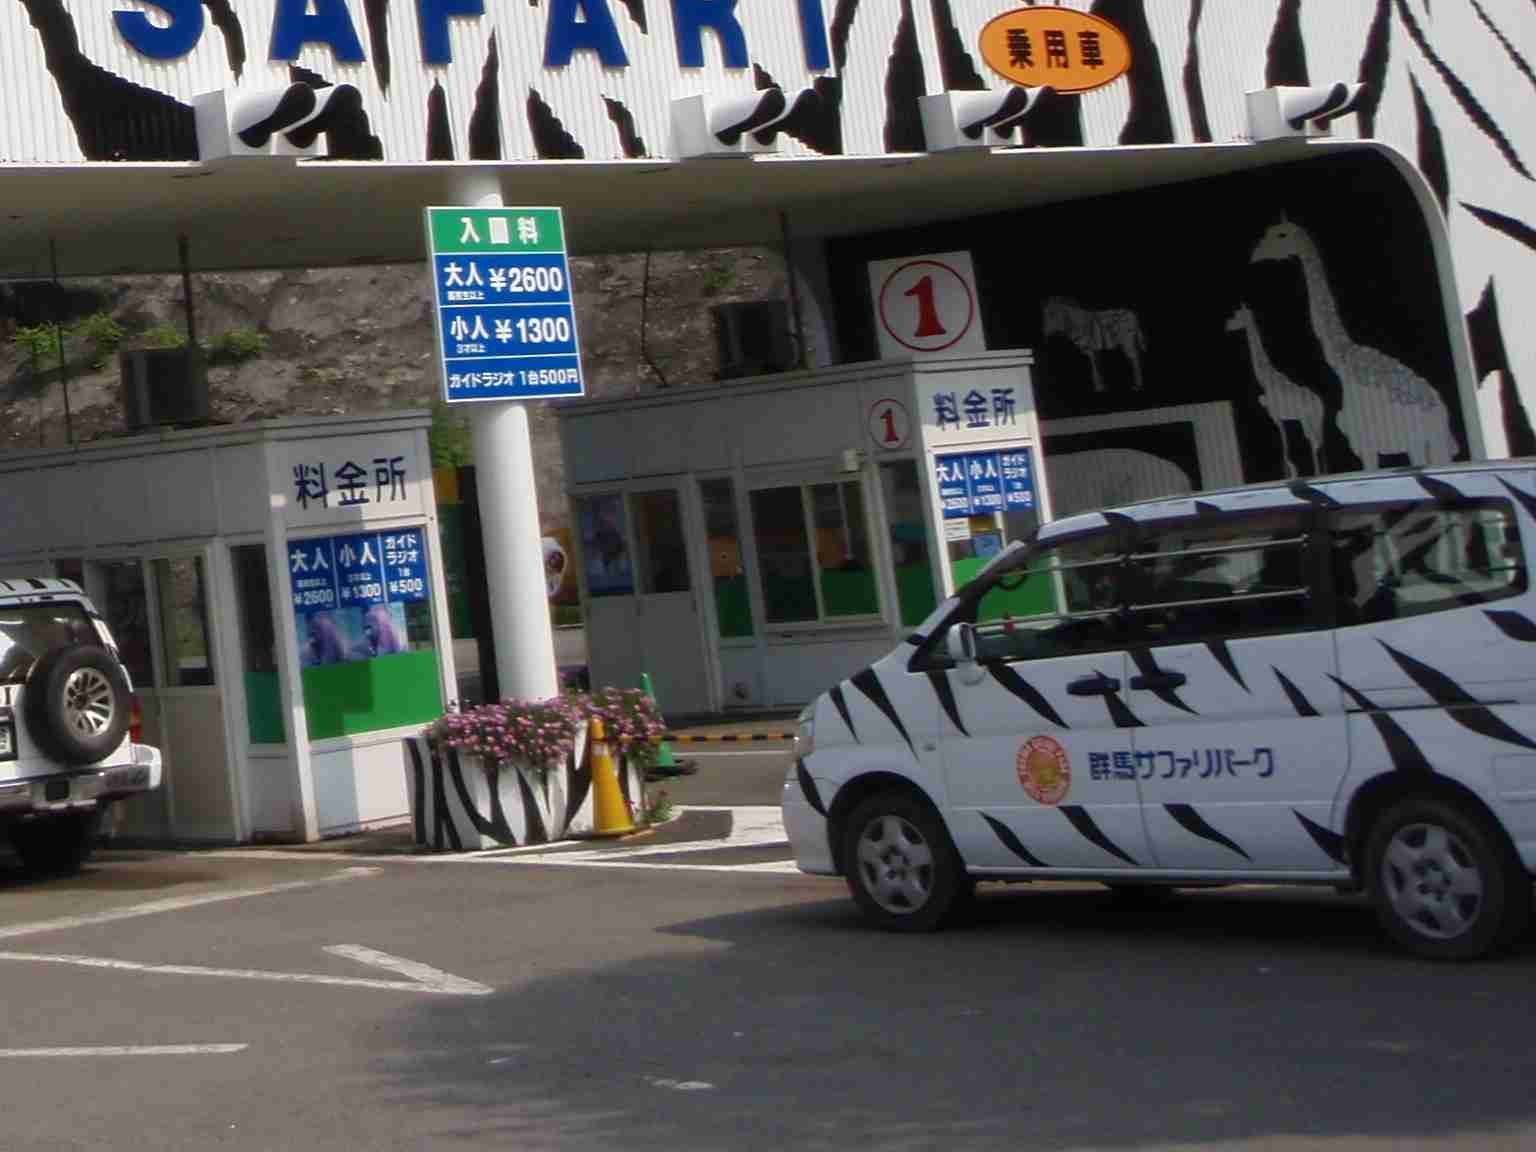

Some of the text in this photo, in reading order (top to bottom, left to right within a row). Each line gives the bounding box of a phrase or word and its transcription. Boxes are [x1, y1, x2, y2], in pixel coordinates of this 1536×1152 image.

[1006, 28, 1104, 69] 乗用車
[444, 262, 563, 292] 大人 ¥2600
[904, 273, 947, 338] 1
[450, 315, 569, 343] 小人 ¥1300
[449, 372, 514, 388] ガイドラジオ
[933, 388, 1017, 431] 料金所
[880, 408, 899, 442] 1
[293, 456, 406, 510] 料金所
[935, 461, 964, 481] 大人
[970, 459, 997, 480] 小人
[339, 541, 376, 568] 小人
[385, 534, 417, 549] ガイド
[290, 547, 329, 573] 大人
[385, 550, 418, 565] ラジオ
[389, 578, 423, 593] ¥500
[1088, 747, 1274, 781] 群馬サファリパーク
